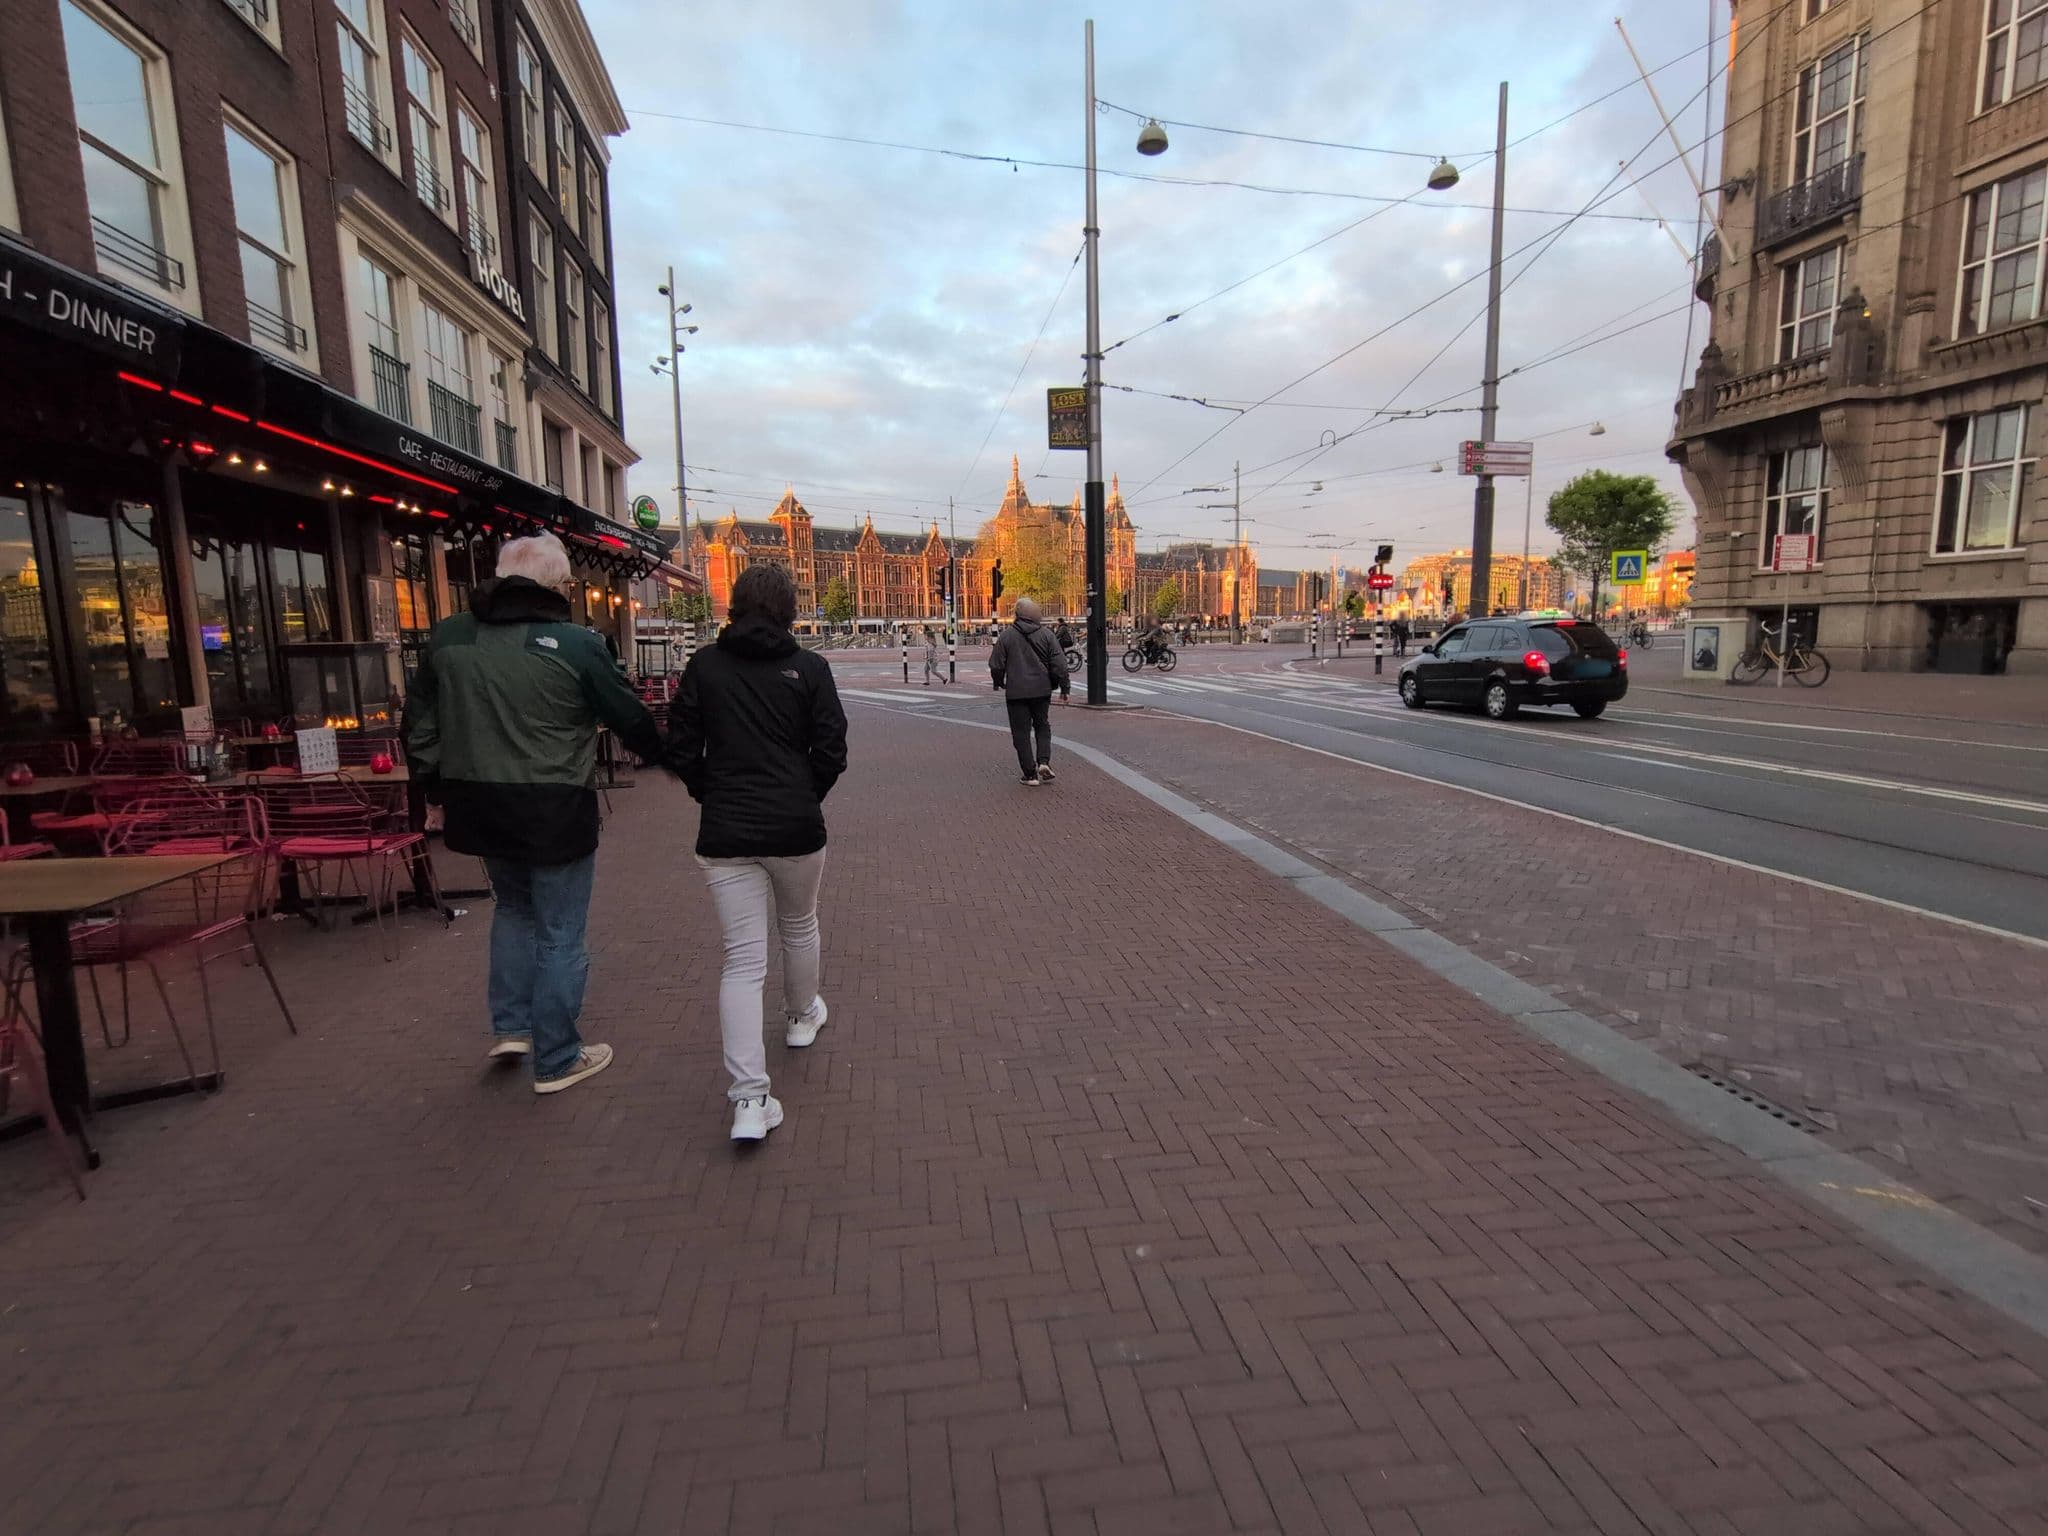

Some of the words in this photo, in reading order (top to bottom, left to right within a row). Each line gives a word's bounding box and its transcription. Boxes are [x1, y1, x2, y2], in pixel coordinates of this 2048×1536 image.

[475, 253, 526, 322] HOTEL
[49, 289, 156, 355] DINNER
[399, 436, 423, 461] CAFE
[429, 451, 484, 484] RESTAURANT
[484, 475, 504, 492] BAR
